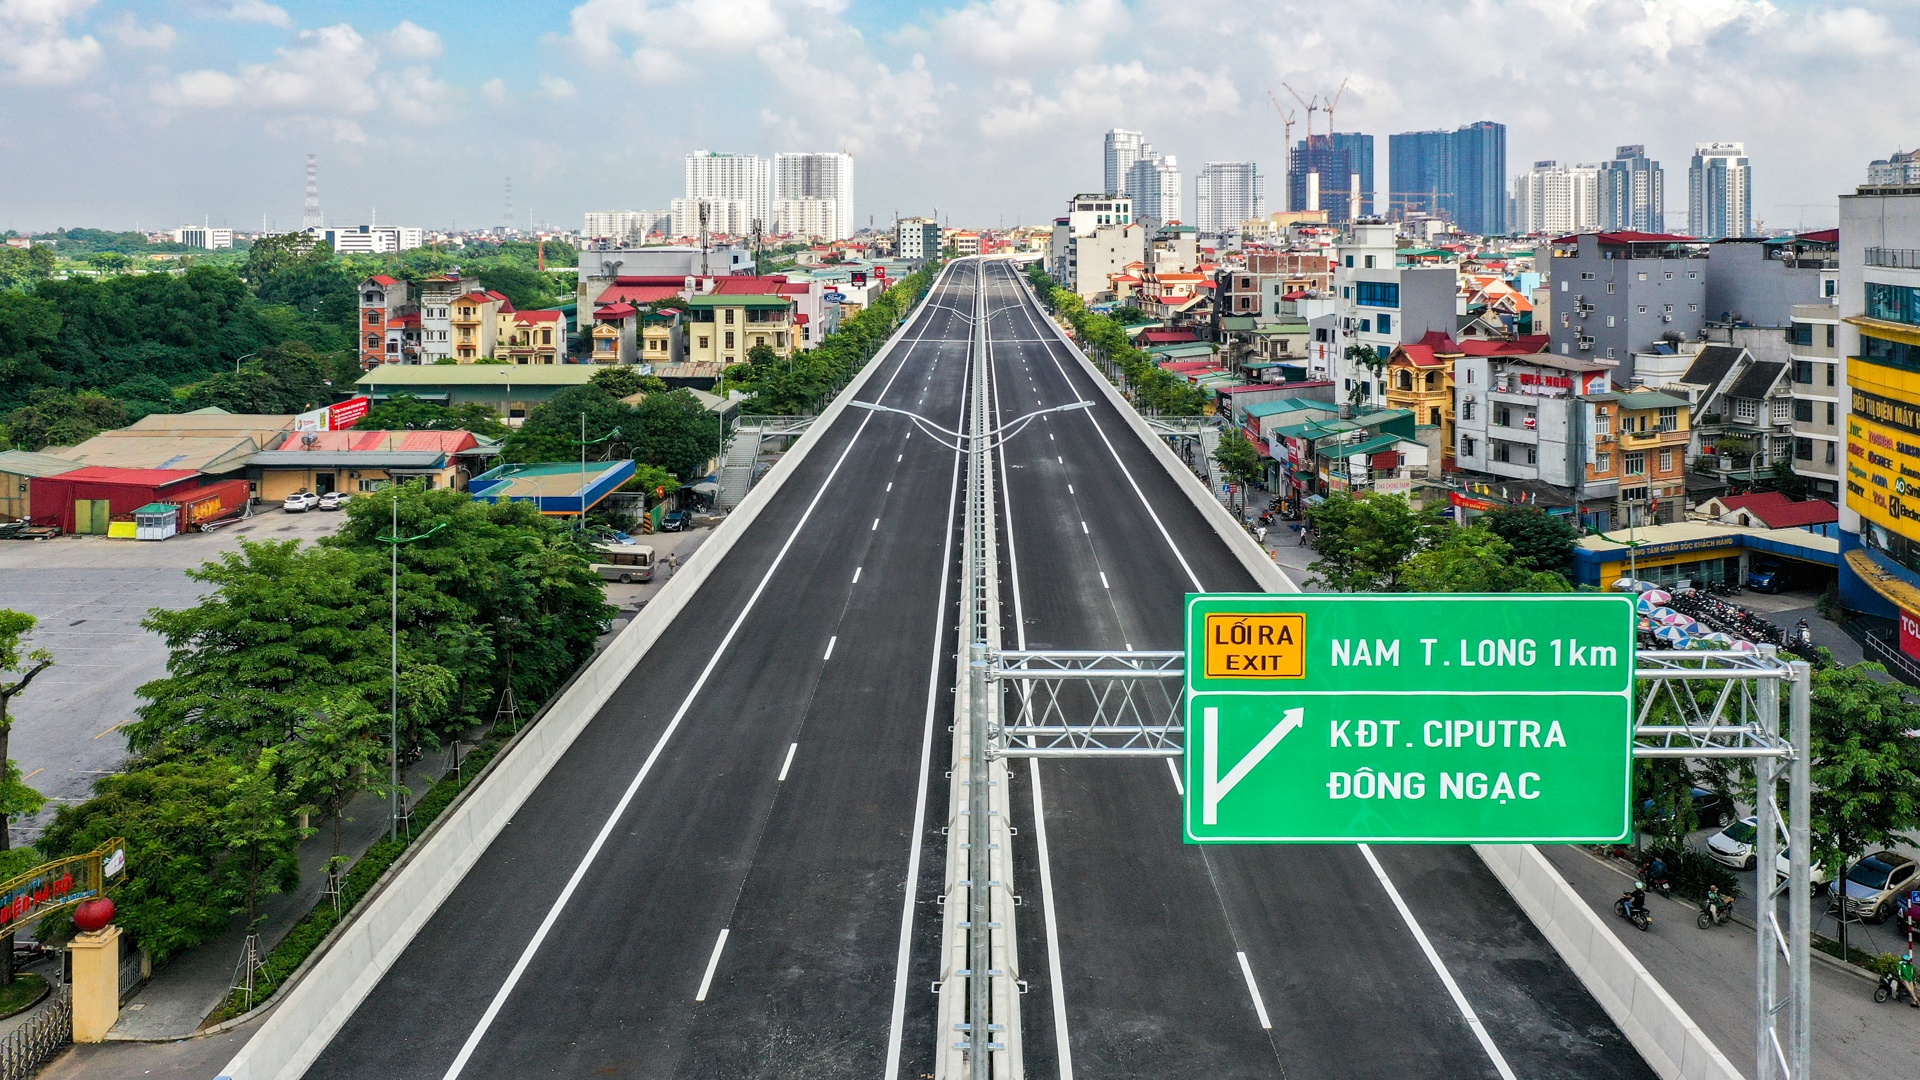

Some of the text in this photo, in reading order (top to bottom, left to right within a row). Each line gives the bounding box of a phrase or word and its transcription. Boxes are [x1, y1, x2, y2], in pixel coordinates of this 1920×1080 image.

[826, 293, 842, 301] Ford
[1852, 393, 1865, 412] SIÊU
[1866, 399, 1876, 419] THỊ
[1895, 406, 1914, 427] MÁY
[1868, 430, 1894, 450] TOSHIBA
[1646, 546, 1659, 555] TÂM
[1680, 540, 1693, 550] SÓC
[1694, 539, 1715, 548] KHÁCH
[1716, 536, 1733, 545] HÀNG
[1215, 617, 1294, 645] LỐI RA
[1901, 615, 1920, 639] TCL
[1226, 654, 1283, 671] EXIT
[1331, 638, 1400, 667] NAM
[1460, 638, 1536, 667] LONG
[1423, 719, 1567, 748] CIPUTRA
[1325, 766, 1541, 805] ĐÔNG NGẠC
